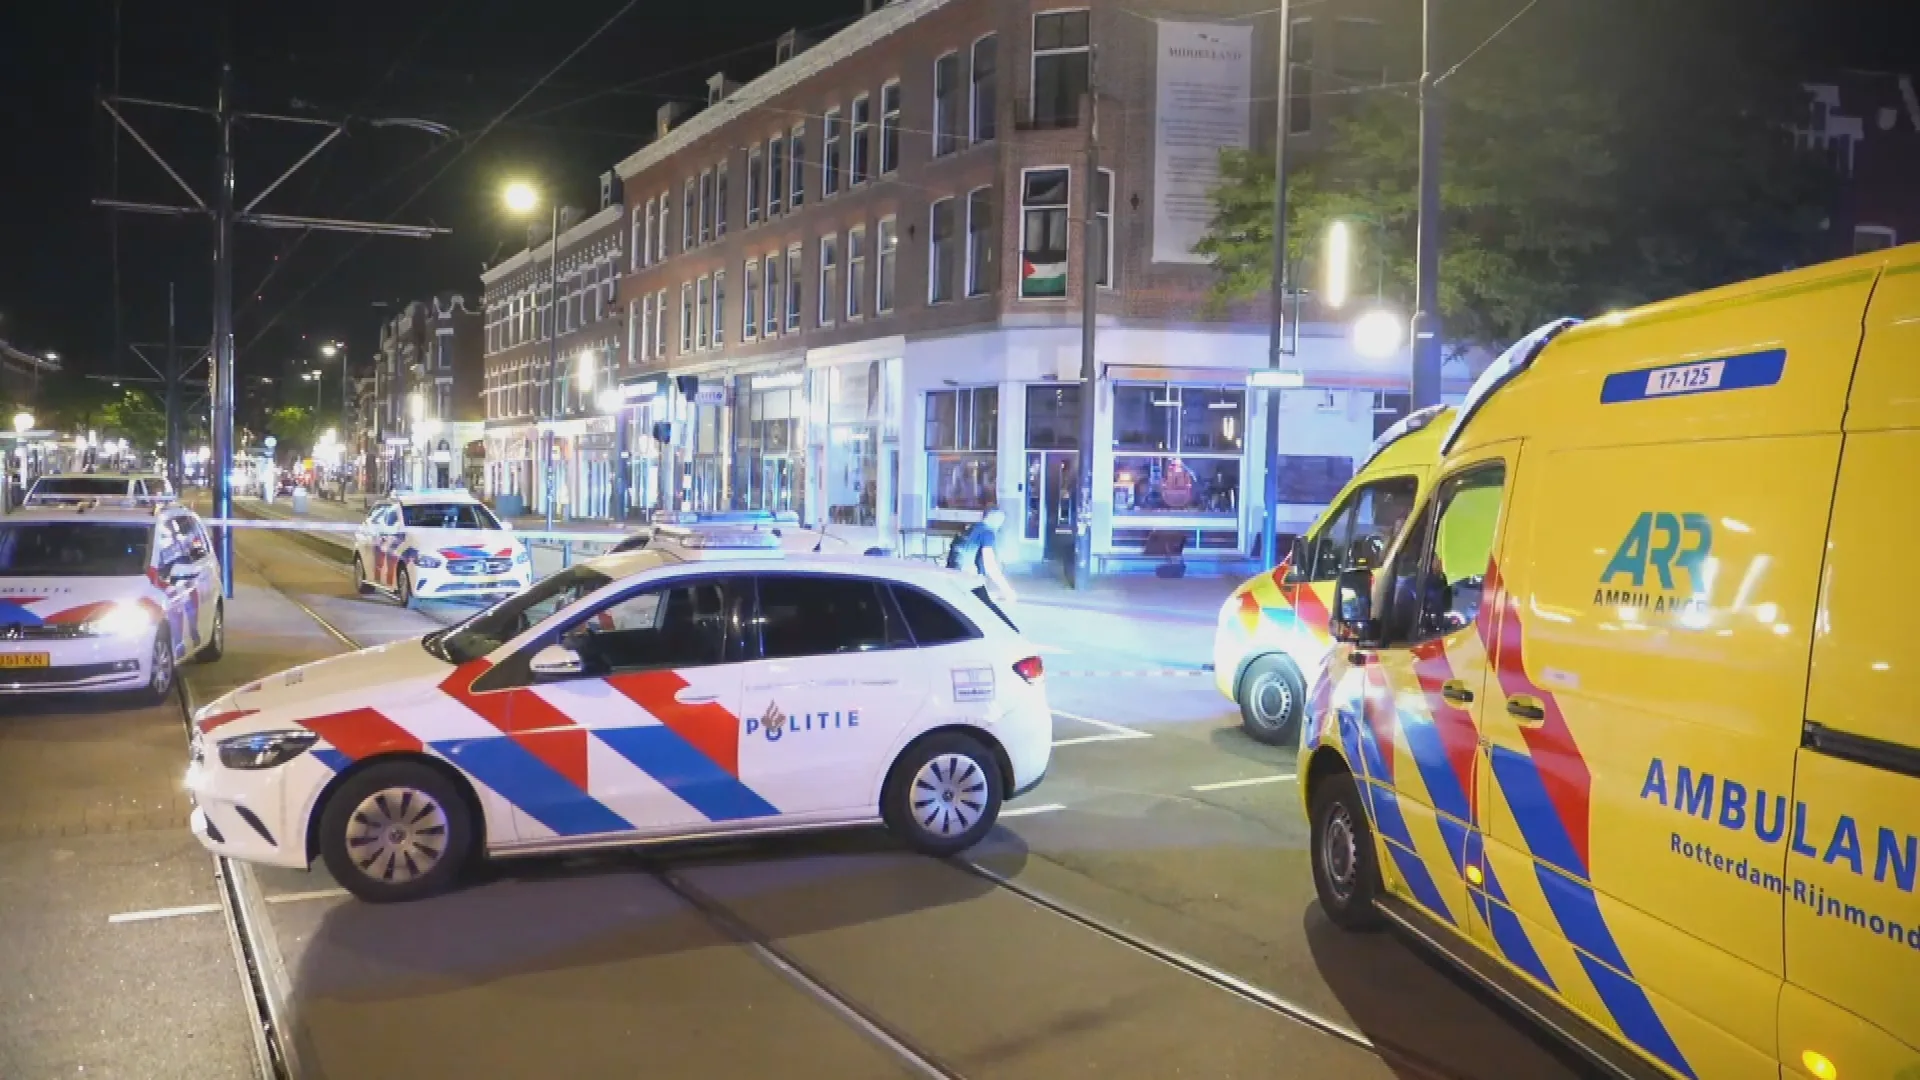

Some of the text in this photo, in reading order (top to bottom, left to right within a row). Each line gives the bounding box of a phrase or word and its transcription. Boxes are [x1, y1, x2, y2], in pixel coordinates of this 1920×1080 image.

[1660, 366, 1711, 390] 17-125
[746, 709, 860, 742] POLITIE
[1640, 757, 1918, 893] AMBULAN
[1671, 832, 1920, 951] Rotterdam-Rijnmond
